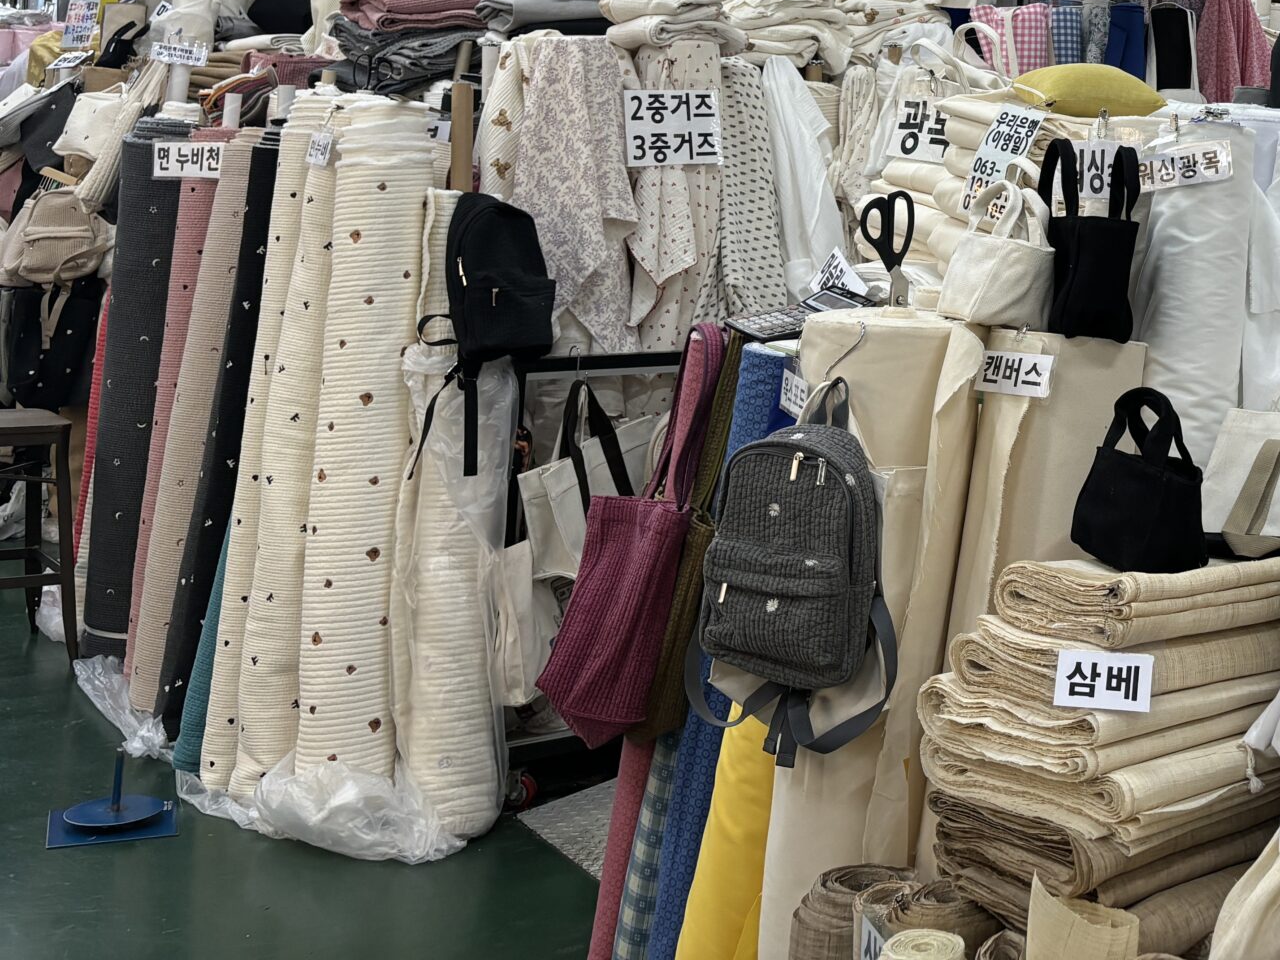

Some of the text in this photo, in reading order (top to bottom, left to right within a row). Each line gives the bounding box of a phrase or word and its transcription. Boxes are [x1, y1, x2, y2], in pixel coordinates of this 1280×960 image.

[630, 95, 716, 124] 2중거즈
[996, 112, 1040, 138] 우리은행
[157, 144, 220, 173] 면 누비천
[633, 132, 720, 164] 3중거즈
[984, 356, 1042, 389] 캔버스
[1065, 663, 1141, 703] 삼베
